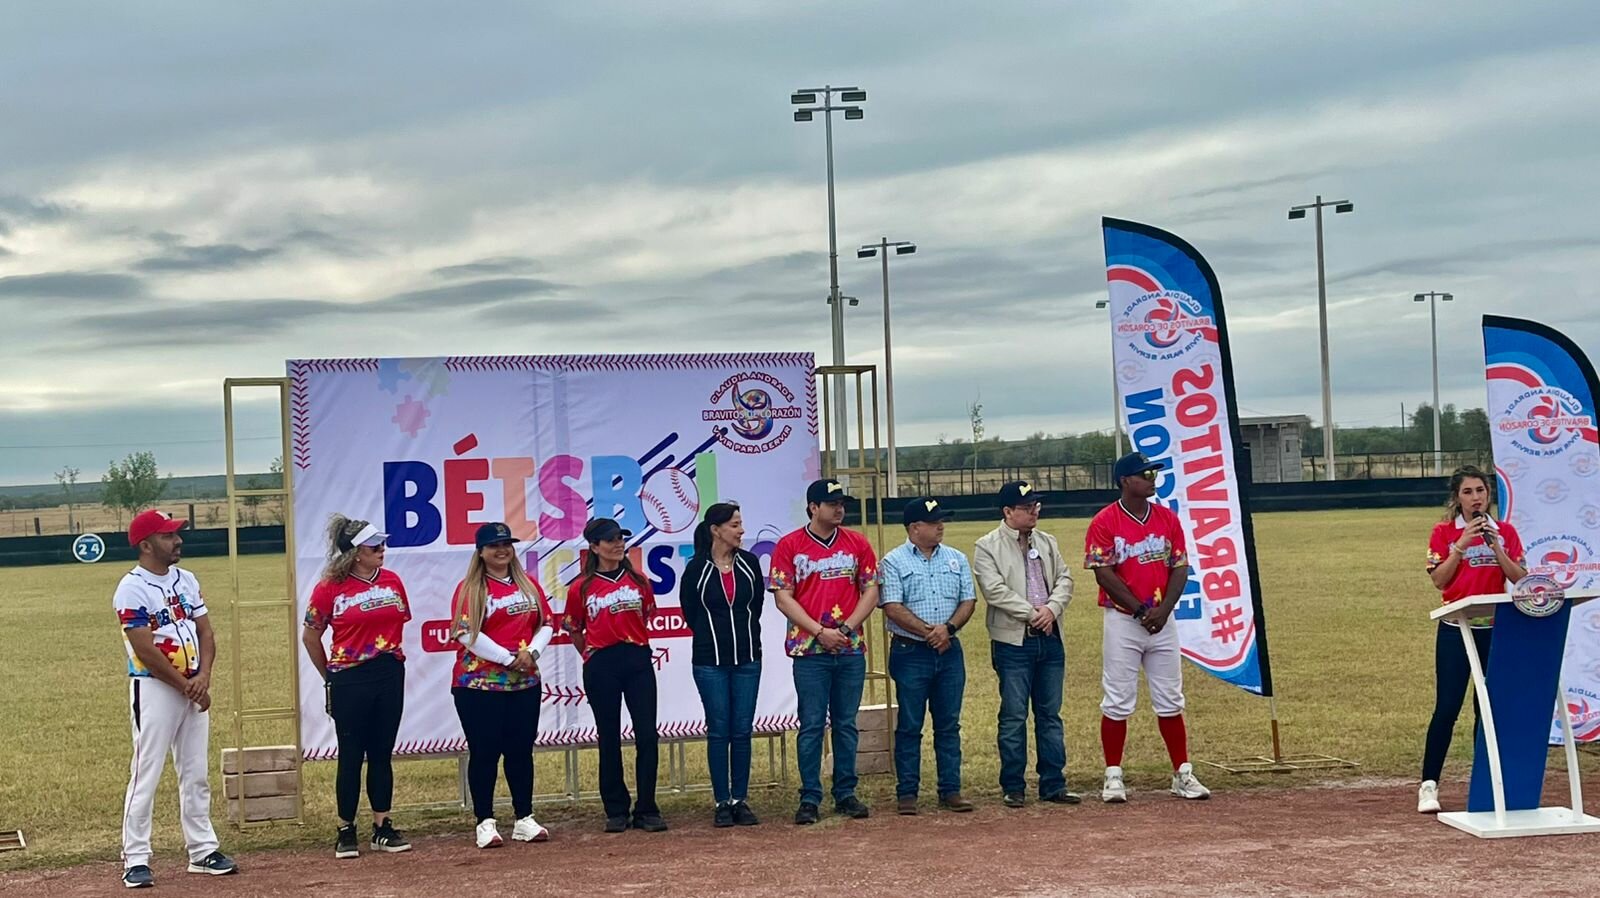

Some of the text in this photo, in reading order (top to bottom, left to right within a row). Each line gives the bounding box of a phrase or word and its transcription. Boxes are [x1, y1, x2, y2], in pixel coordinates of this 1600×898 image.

[710, 371, 794, 404] CLAUDIA ANDRADE
[703, 409, 744, 421] BRAVITOS
[761, 405, 801, 419] CORAZÓN
[734, 442, 760, 453] PARA
[761, 425, 792, 452] SERVIR
